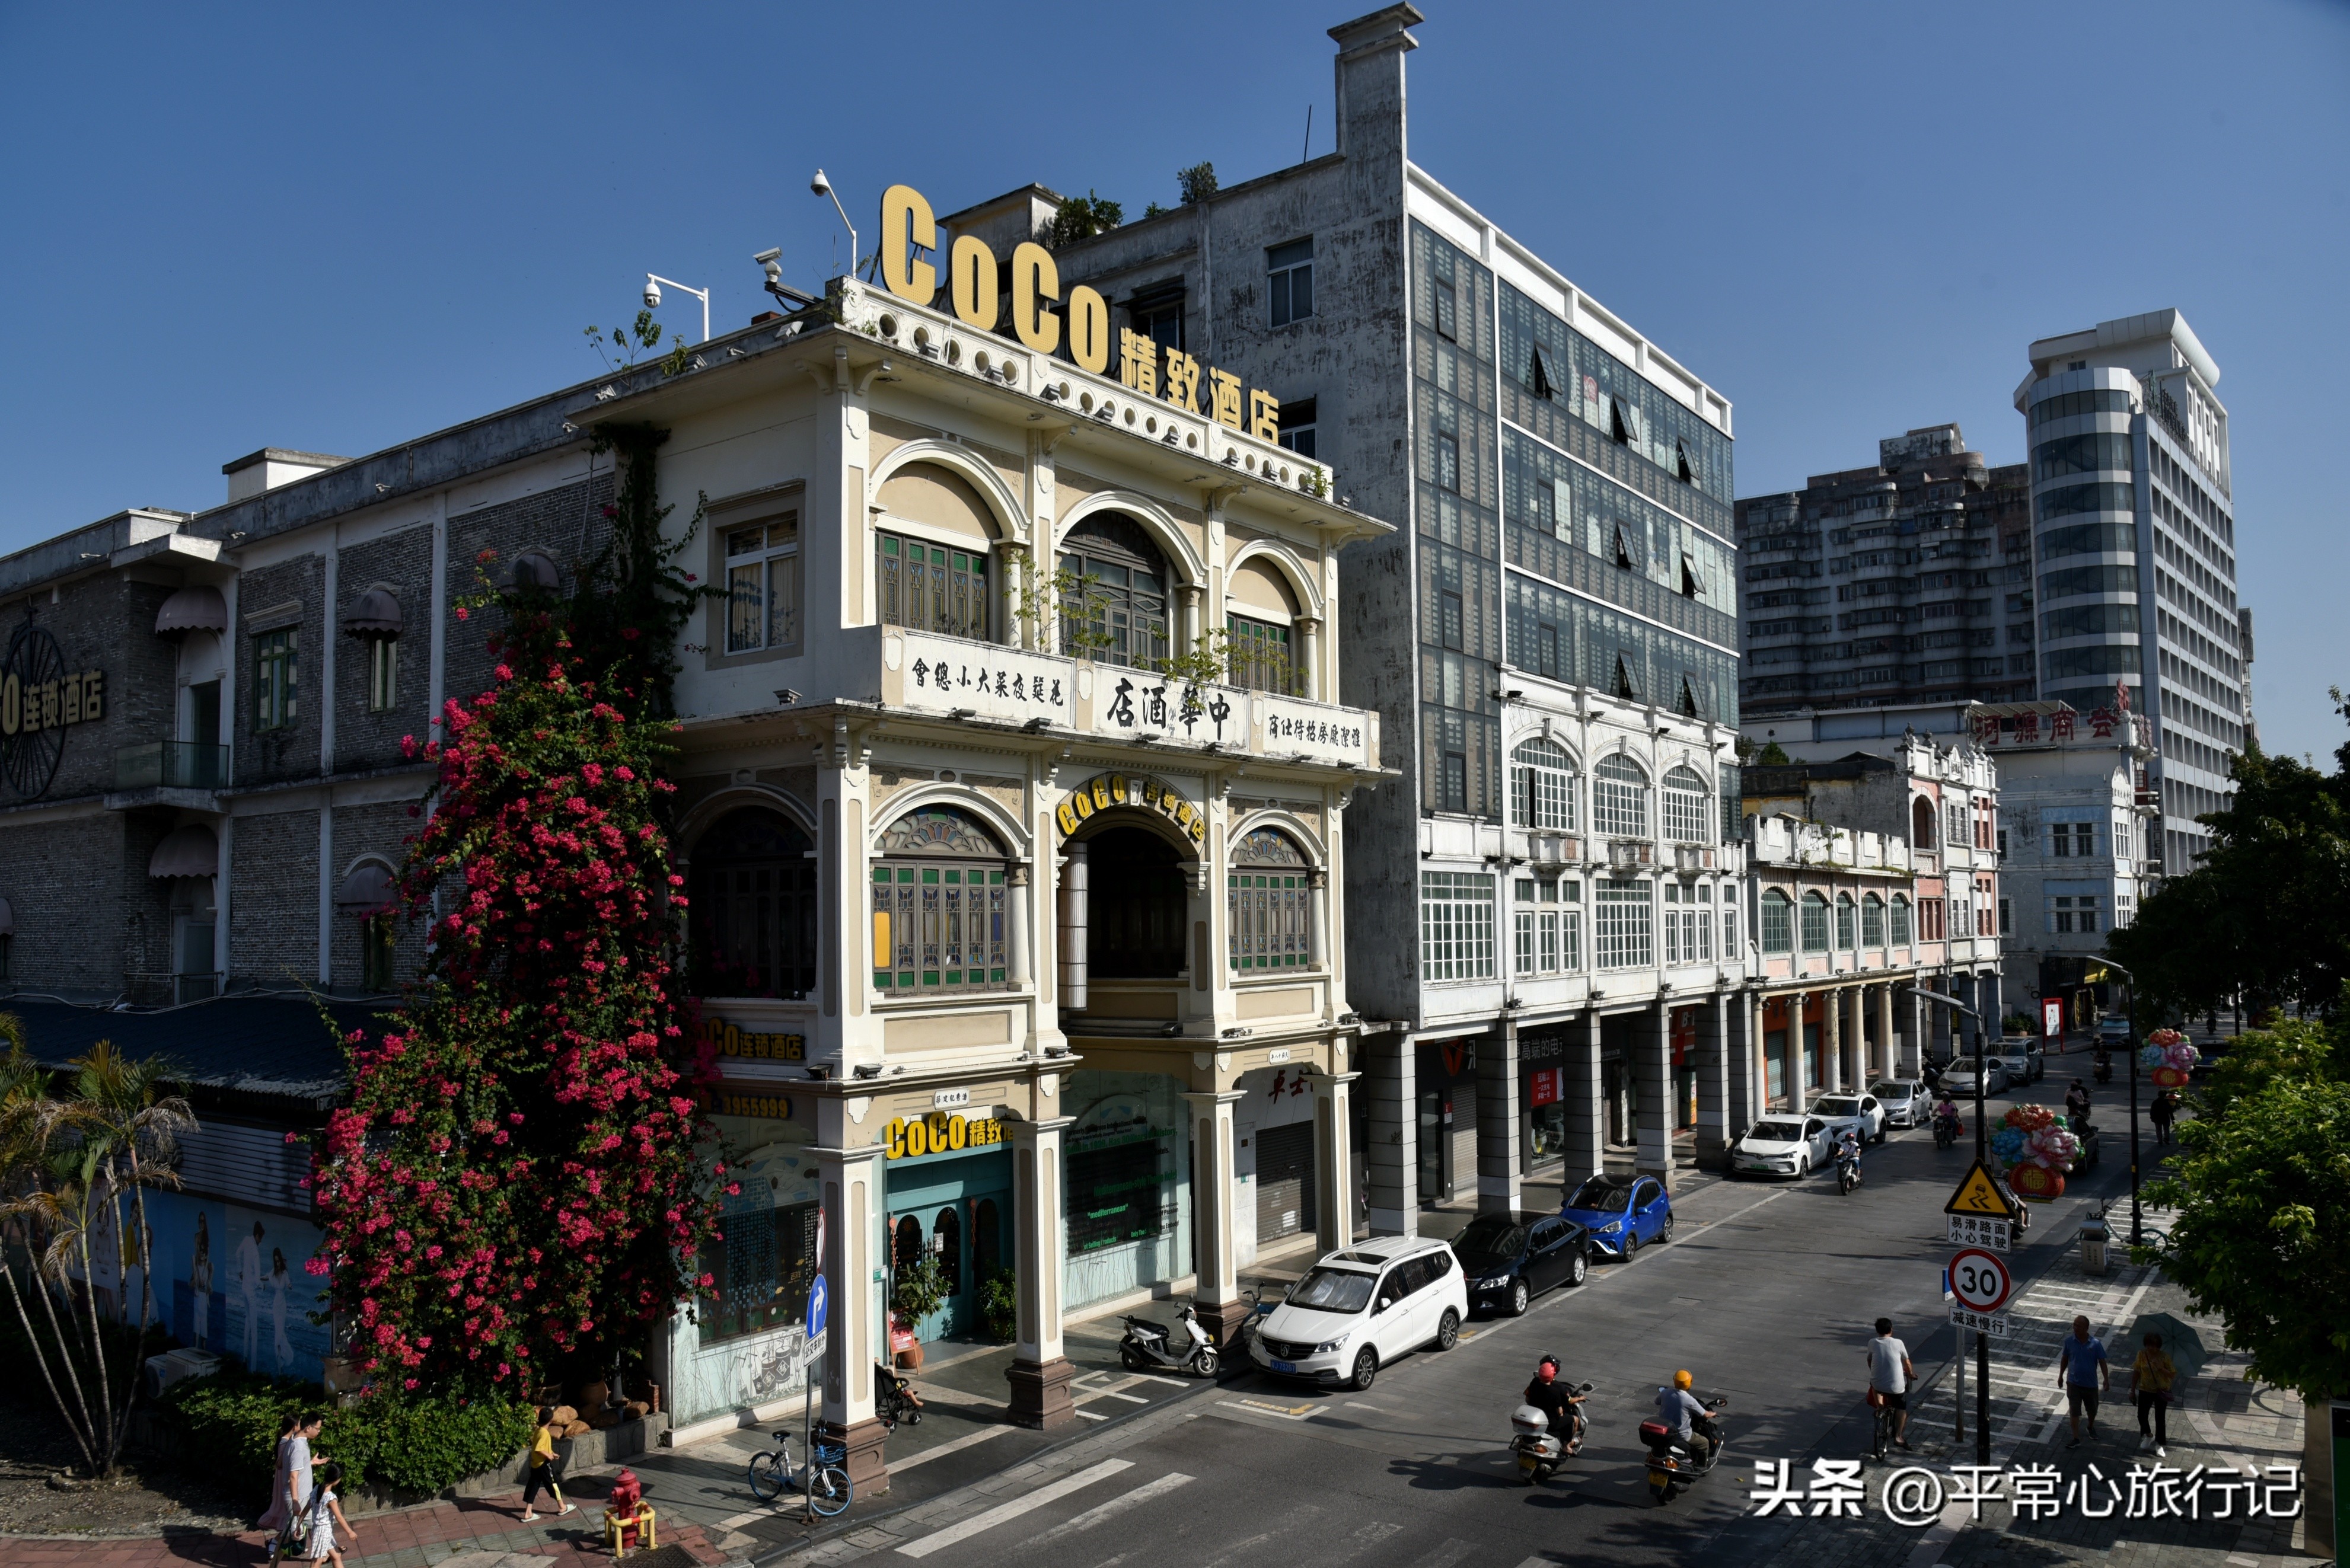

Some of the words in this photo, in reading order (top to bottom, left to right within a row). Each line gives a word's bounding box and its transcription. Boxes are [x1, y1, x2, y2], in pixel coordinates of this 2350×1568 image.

[1120, 326, 1279, 445] 精致酒店
[23, 669, 102, 733] 连锁酒店
[1107, 678, 1230, 741] 中華酒店
[1975, 705, 2118, 745] 河源商会
[1147, 781, 1206, 842] 连锁酒店
[739, 1033, 803, 1060] 连锁酒店
[1268, 1069, 1313, 1104] 卓士
[723, 1095, 789, 1118] 3955999
[2022, 1168, 2046, 1190] 福
[1951, 1216, 2005, 1235] 易滑路面
[1951, 1230, 2006, 1249] 小心驾驶
[1961, 1266, 1997, 1296] 30
[1952, 1311, 2005, 1334] 减速慢行
